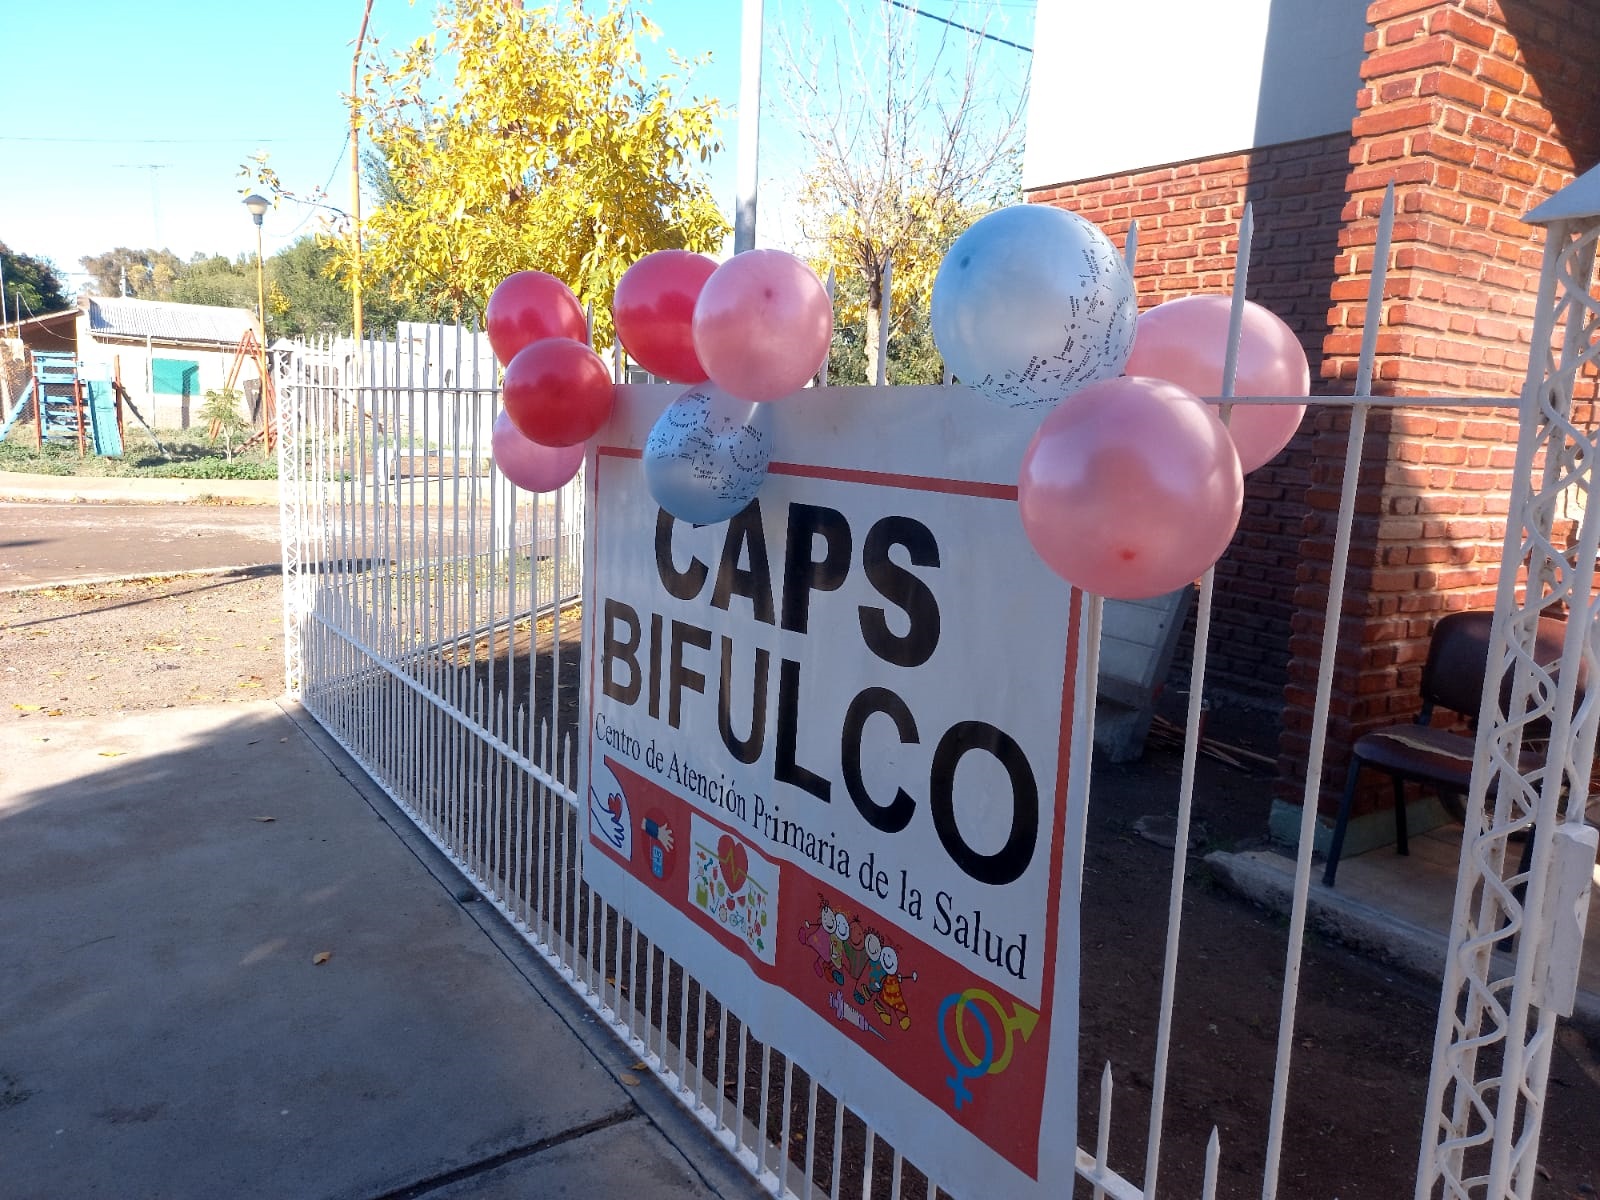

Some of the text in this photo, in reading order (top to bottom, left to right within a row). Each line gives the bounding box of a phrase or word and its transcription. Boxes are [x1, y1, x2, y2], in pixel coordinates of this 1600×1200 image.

[655, 497, 941, 667] CAPS
[596, 713, 1027, 979] Centro de Atención Primaria de la Salud
[602, 598, 1039, 886] BIFULCO
